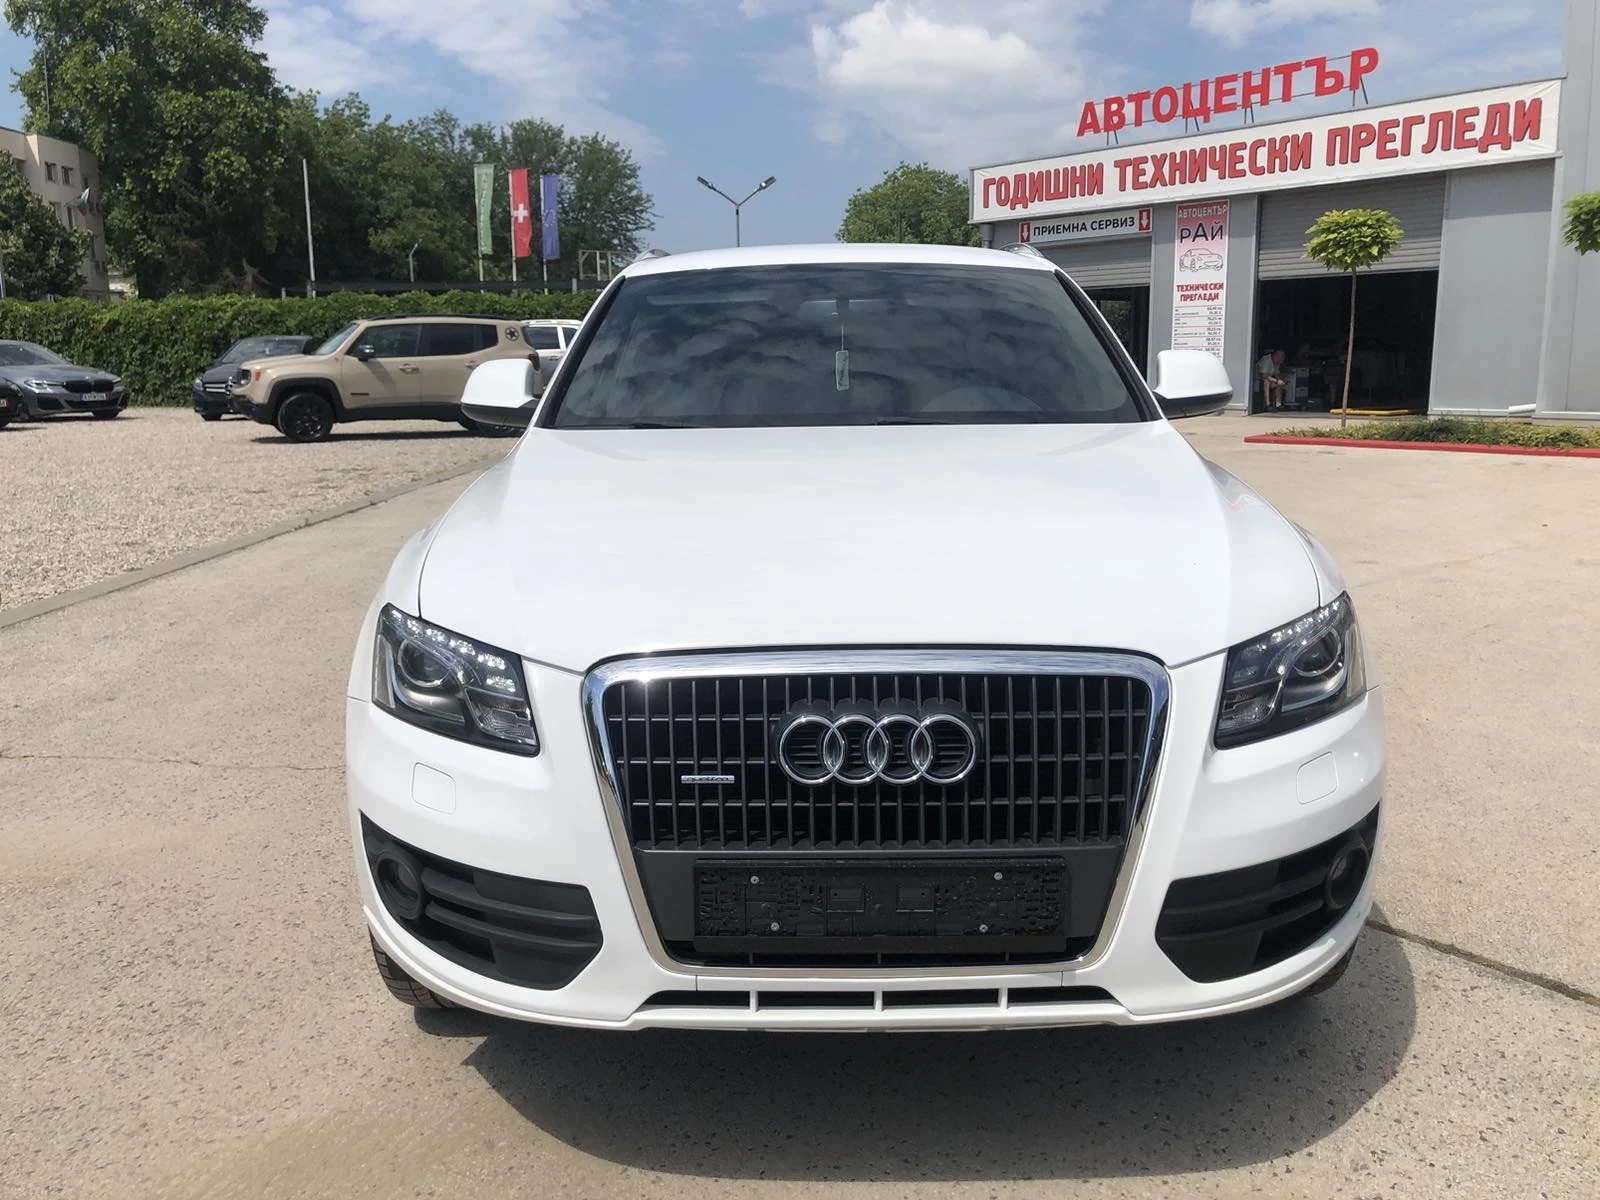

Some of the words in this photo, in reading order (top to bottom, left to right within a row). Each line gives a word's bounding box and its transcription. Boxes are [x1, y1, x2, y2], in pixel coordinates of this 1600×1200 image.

[1076, 47, 1379, 137] АВТОЦЕНТЪР
[982, 162, 1104, 210] ГОДИШНИ
[1114, 132, 1313, 192] ТЕХНИЧЕСКИ
[1325, 97, 1543, 166] ПРЕГЛЕДИ
[1178, 204, 1228, 219] АВТОЦЕНТЪР
[1033, 221, 1088, 238] ПРИЕМНА
[1091, 216, 1136, 232] СЕРВИЗ
[1179, 220, 1224, 244] РАЙ
[1176, 281, 1224, 293] ТЕХНИЧЕСКИ
[1180, 292, 1219, 302] ПРЕГЛЕДИ
